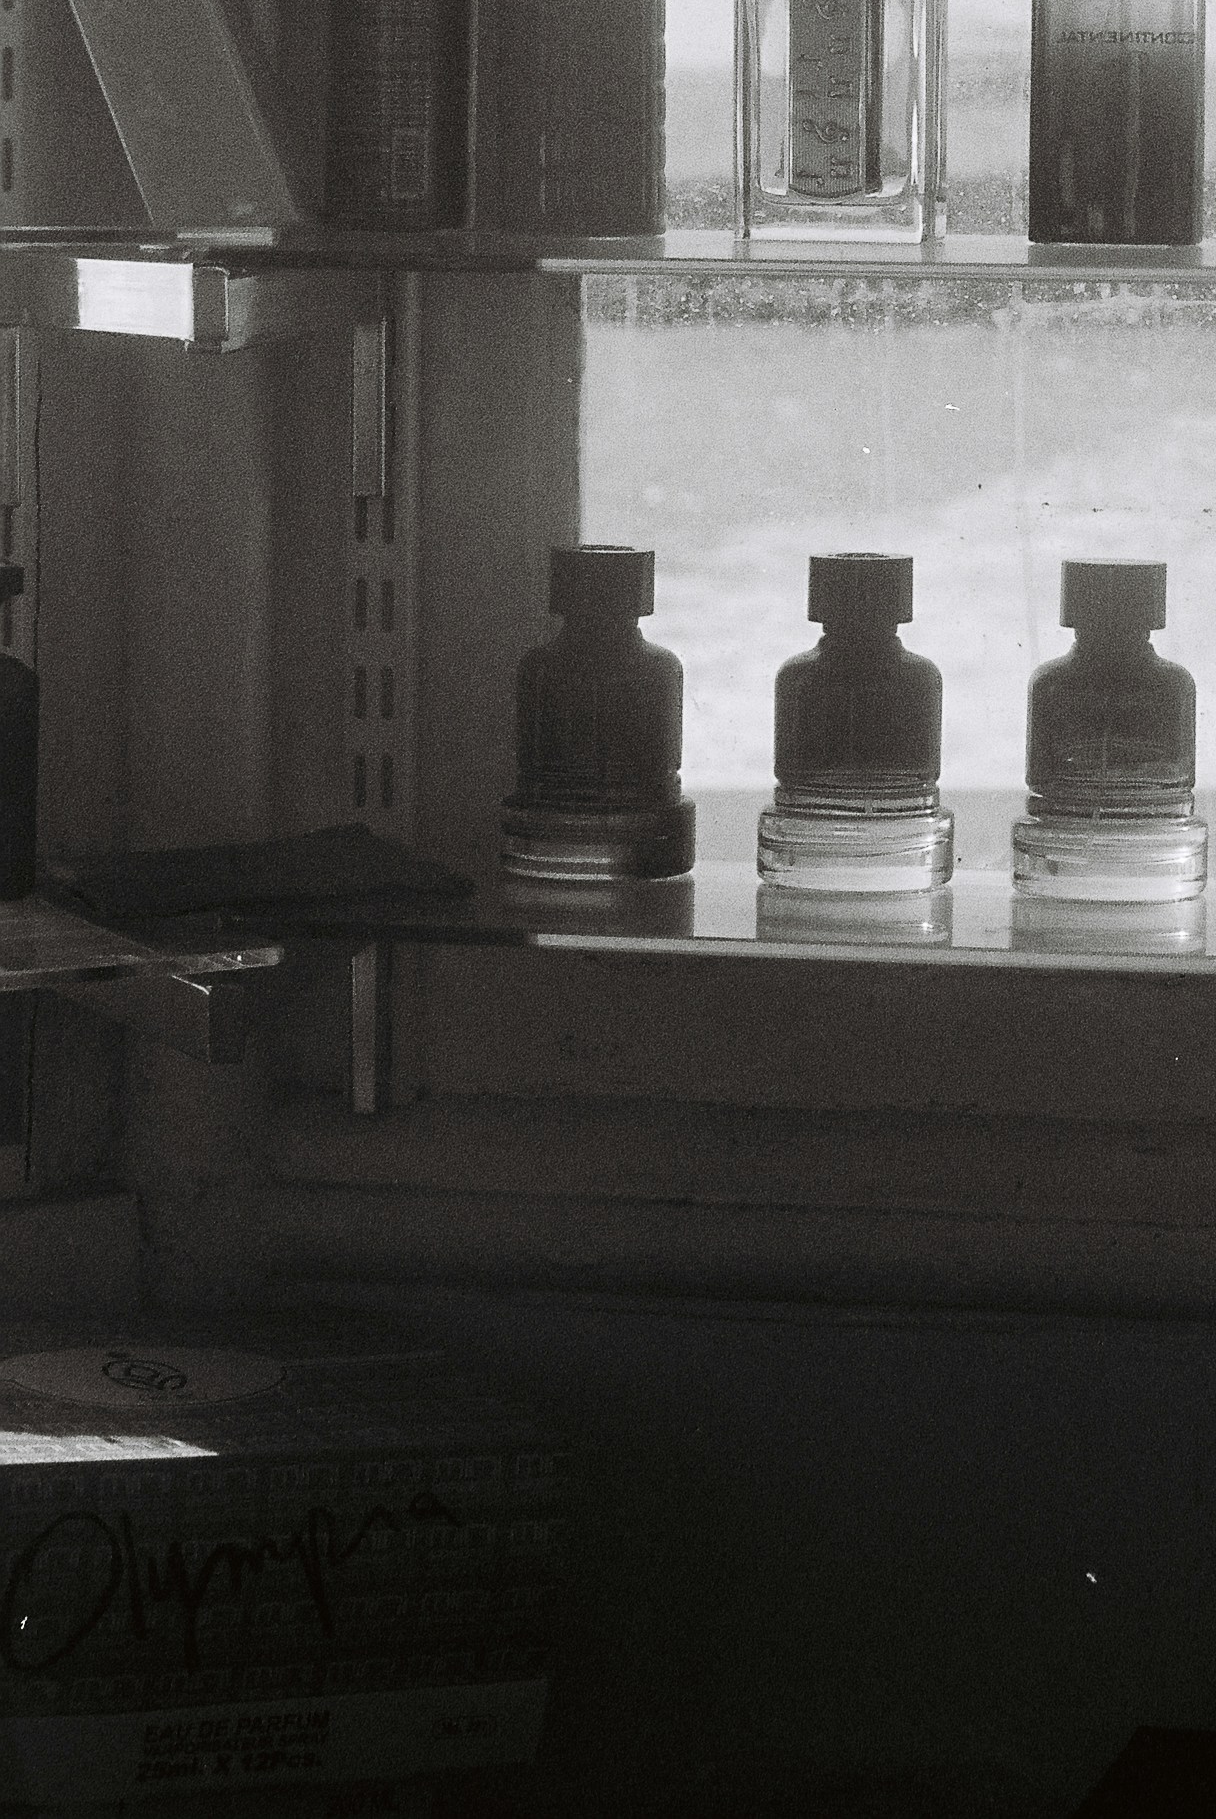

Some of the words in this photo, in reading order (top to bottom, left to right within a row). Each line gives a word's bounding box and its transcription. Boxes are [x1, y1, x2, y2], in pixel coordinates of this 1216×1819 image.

[144, 1723, 192, 1743] EAU
[198, 1717, 231, 1739] DE
[235, 1709, 331, 1735] PARFUM
